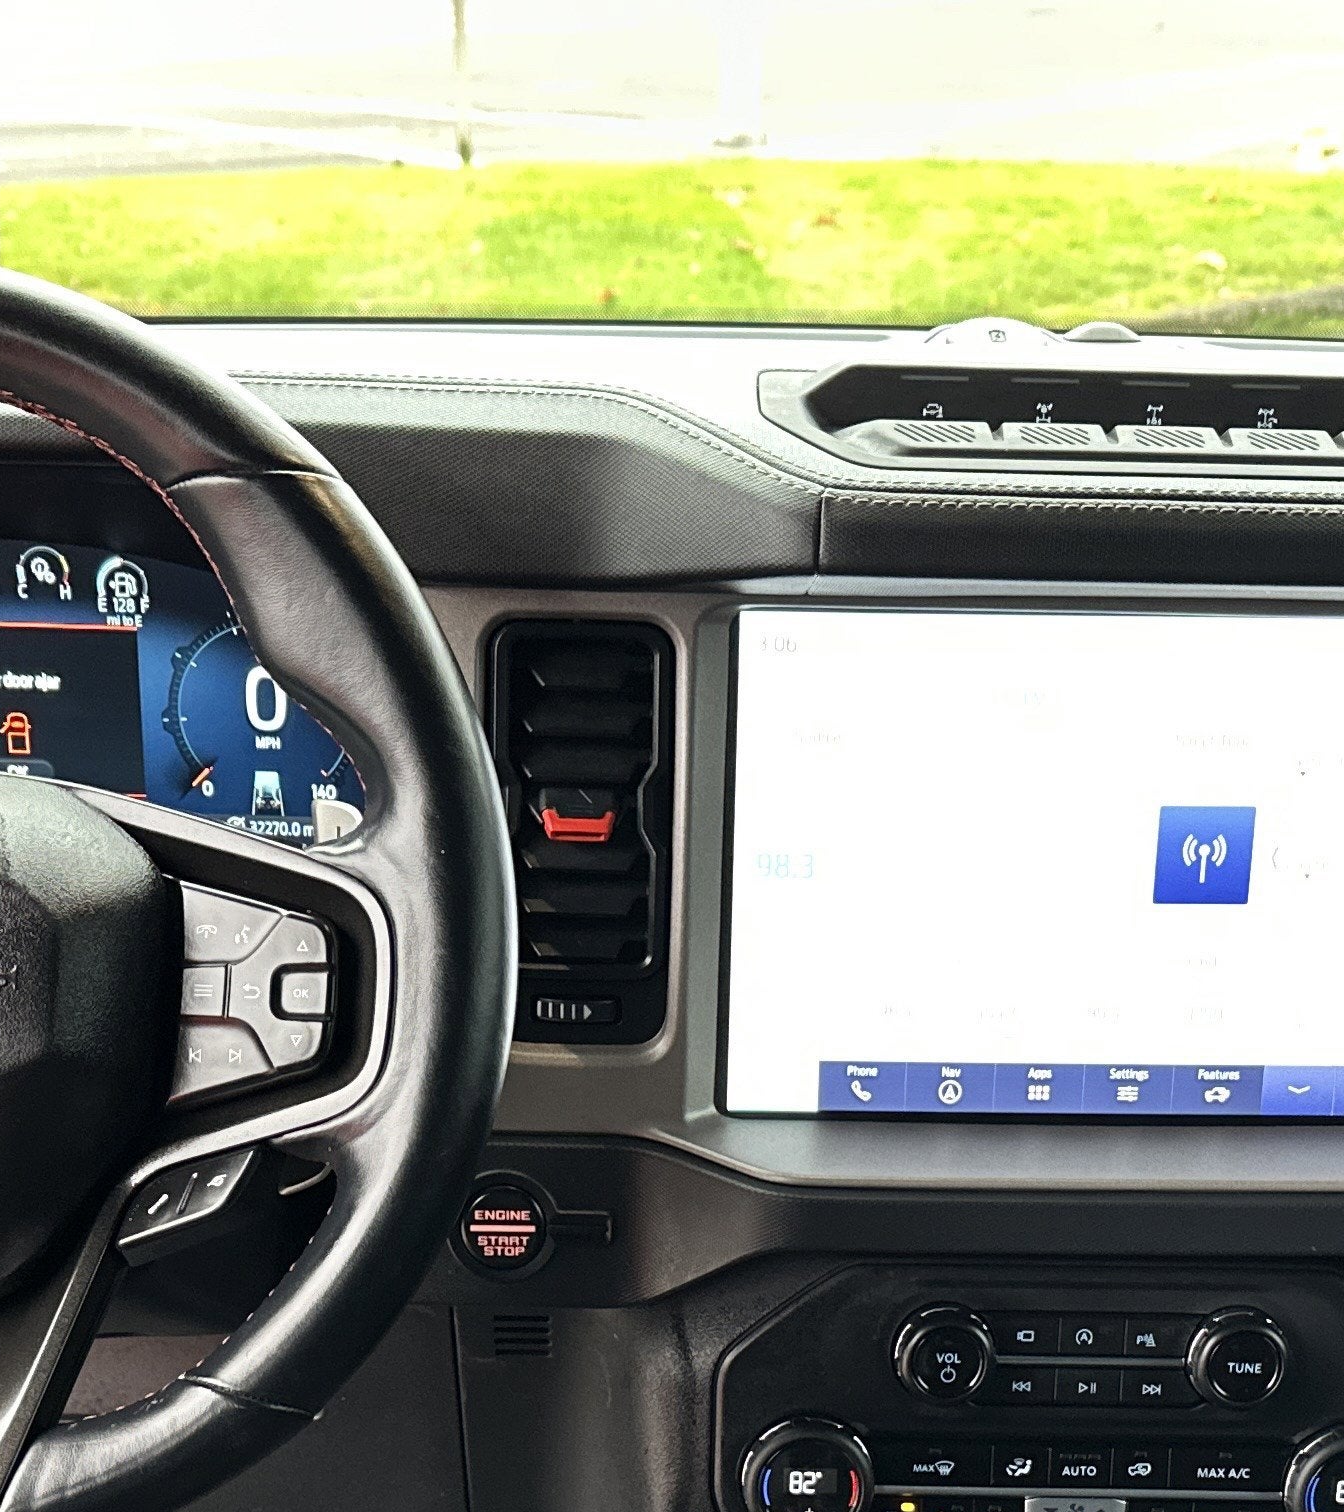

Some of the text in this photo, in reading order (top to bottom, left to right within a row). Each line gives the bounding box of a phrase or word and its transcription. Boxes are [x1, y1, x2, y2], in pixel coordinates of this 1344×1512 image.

[17, 584, 29, 599] C
[60, 584, 72, 600] H
[97, 597, 150, 613] E 128 F
[3, 670, 34, 689] door
[35, 672, 61, 692] ajar
[245, 665, 287, 732] 0
[255, 736, 281, 750] MPH
[201, 780, 214, 797] 0
[310, 784, 338, 800] 140
[758, 854, 813, 878] 98.3
[293, 987, 309, 998] OK
[846, 1065, 878, 1077] Phone
[942, 1066, 961, 1078] Nav
[1027, 1067, 1052, 1080] Apps
[1109, 1068, 1149, 1082] Settings
[1197, 1069, 1240, 1081] Features
[474, 1210, 531, 1221] ENGINE
[477, 1236, 530, 1246] START
[484, 1246, 525, 1257] STOP
[936, 1353, 962, 1365] VOL
[1227, 1362, 1263, 1375] TUNE
[912, 1463, 935, 1473] MAX
[1061, 1465, 1097, 1476] AUTO
[1197, 1467, 1251, 1479] MAX A/C
